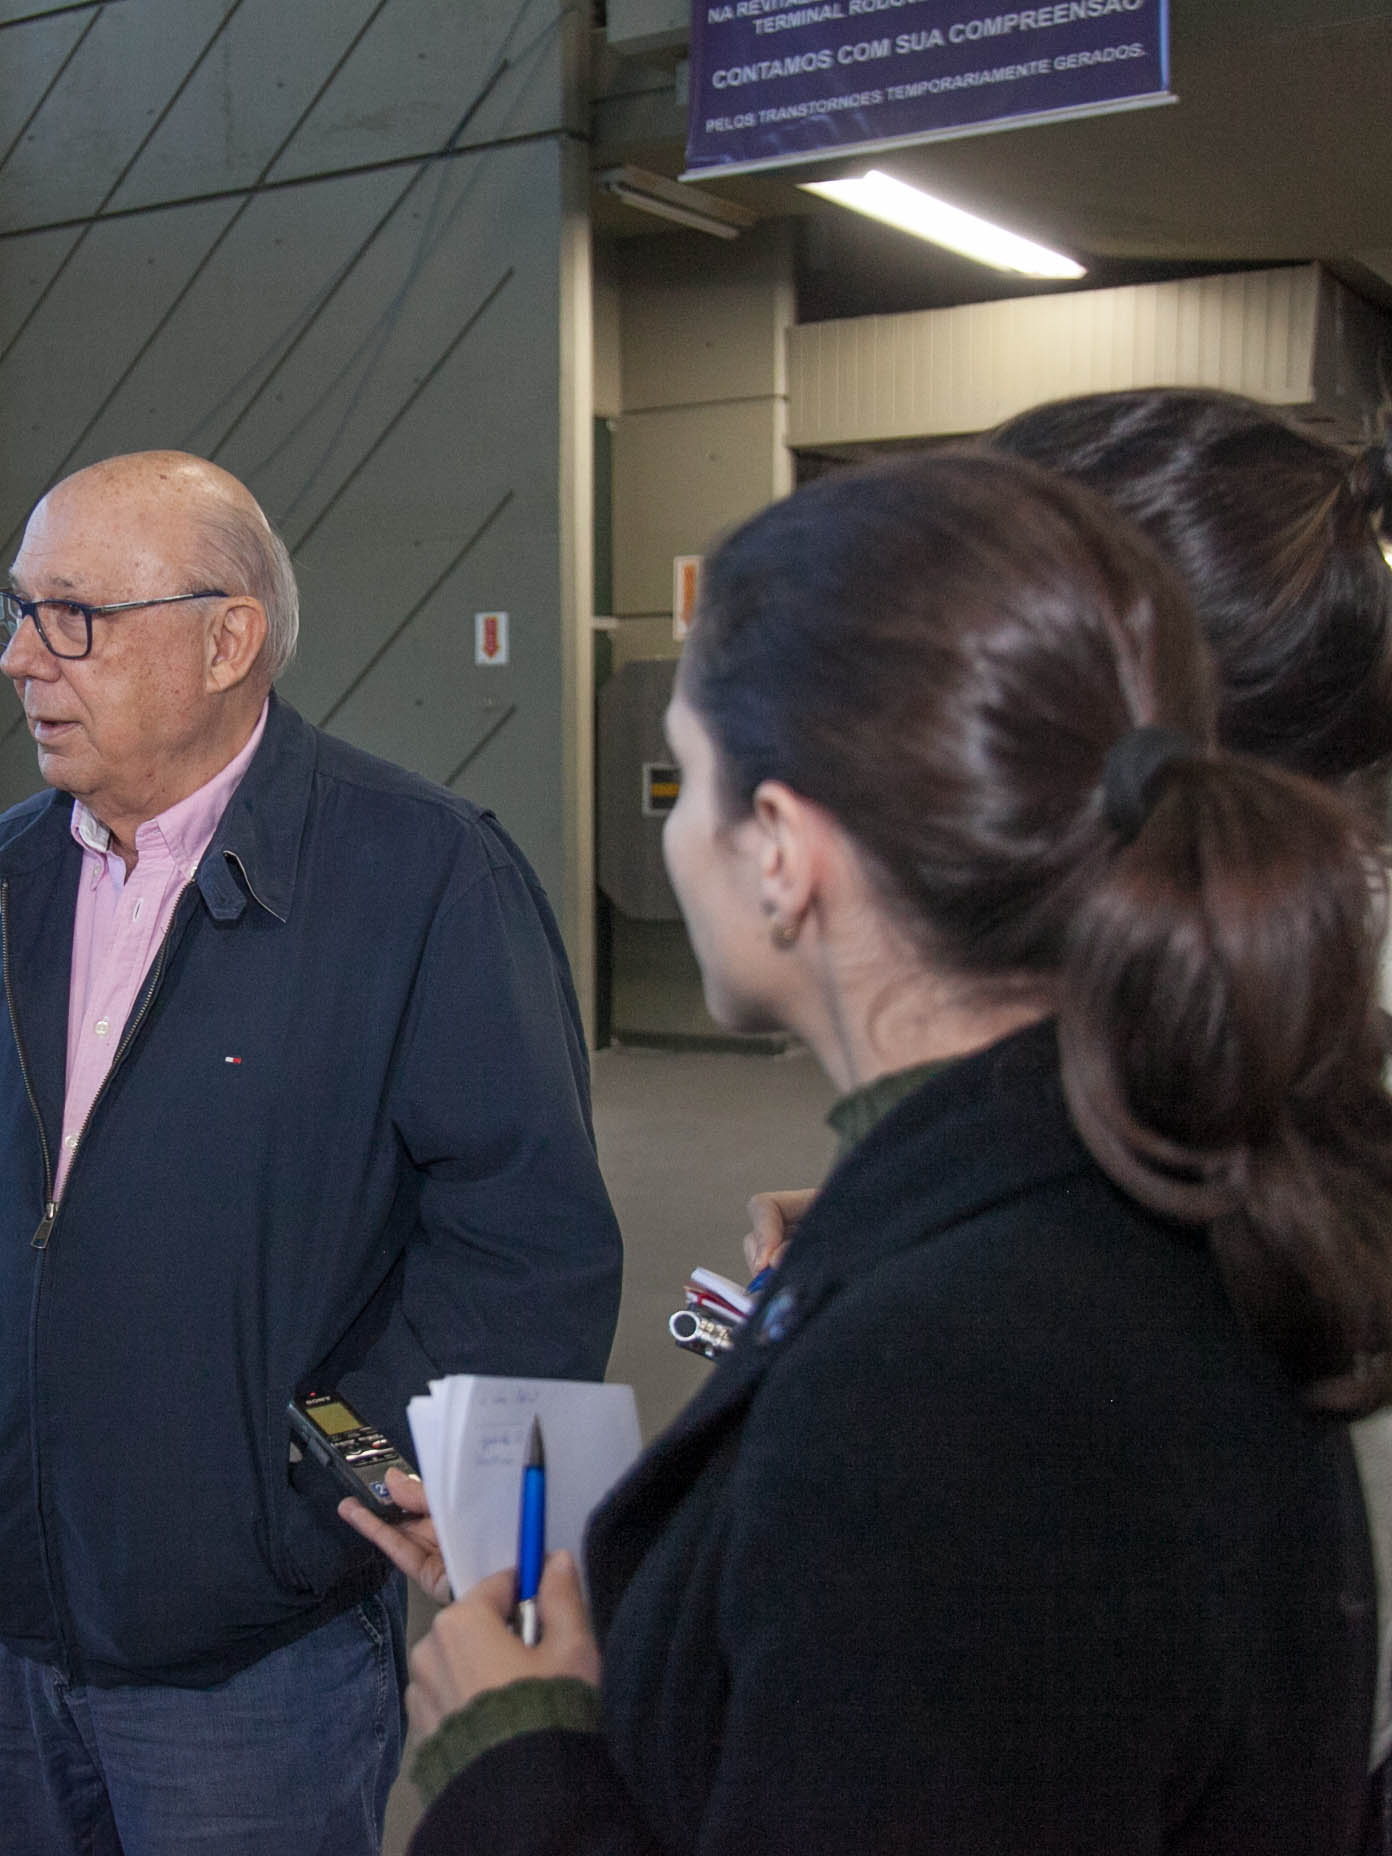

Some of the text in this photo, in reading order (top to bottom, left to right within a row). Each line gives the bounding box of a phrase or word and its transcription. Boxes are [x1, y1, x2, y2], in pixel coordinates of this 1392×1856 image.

[708, 7, 733, 24] NA
[752, 3, 847, 34] TERMINAL
[712, 50, 834, 89] CONTAMOS
[837, 38, 891, 65] COM
[895, 28, 944, 54] SUA
[706, 110, 755, 133] PELOS
[887, 59, 1051, 100] TEMPORARIAMENTE
